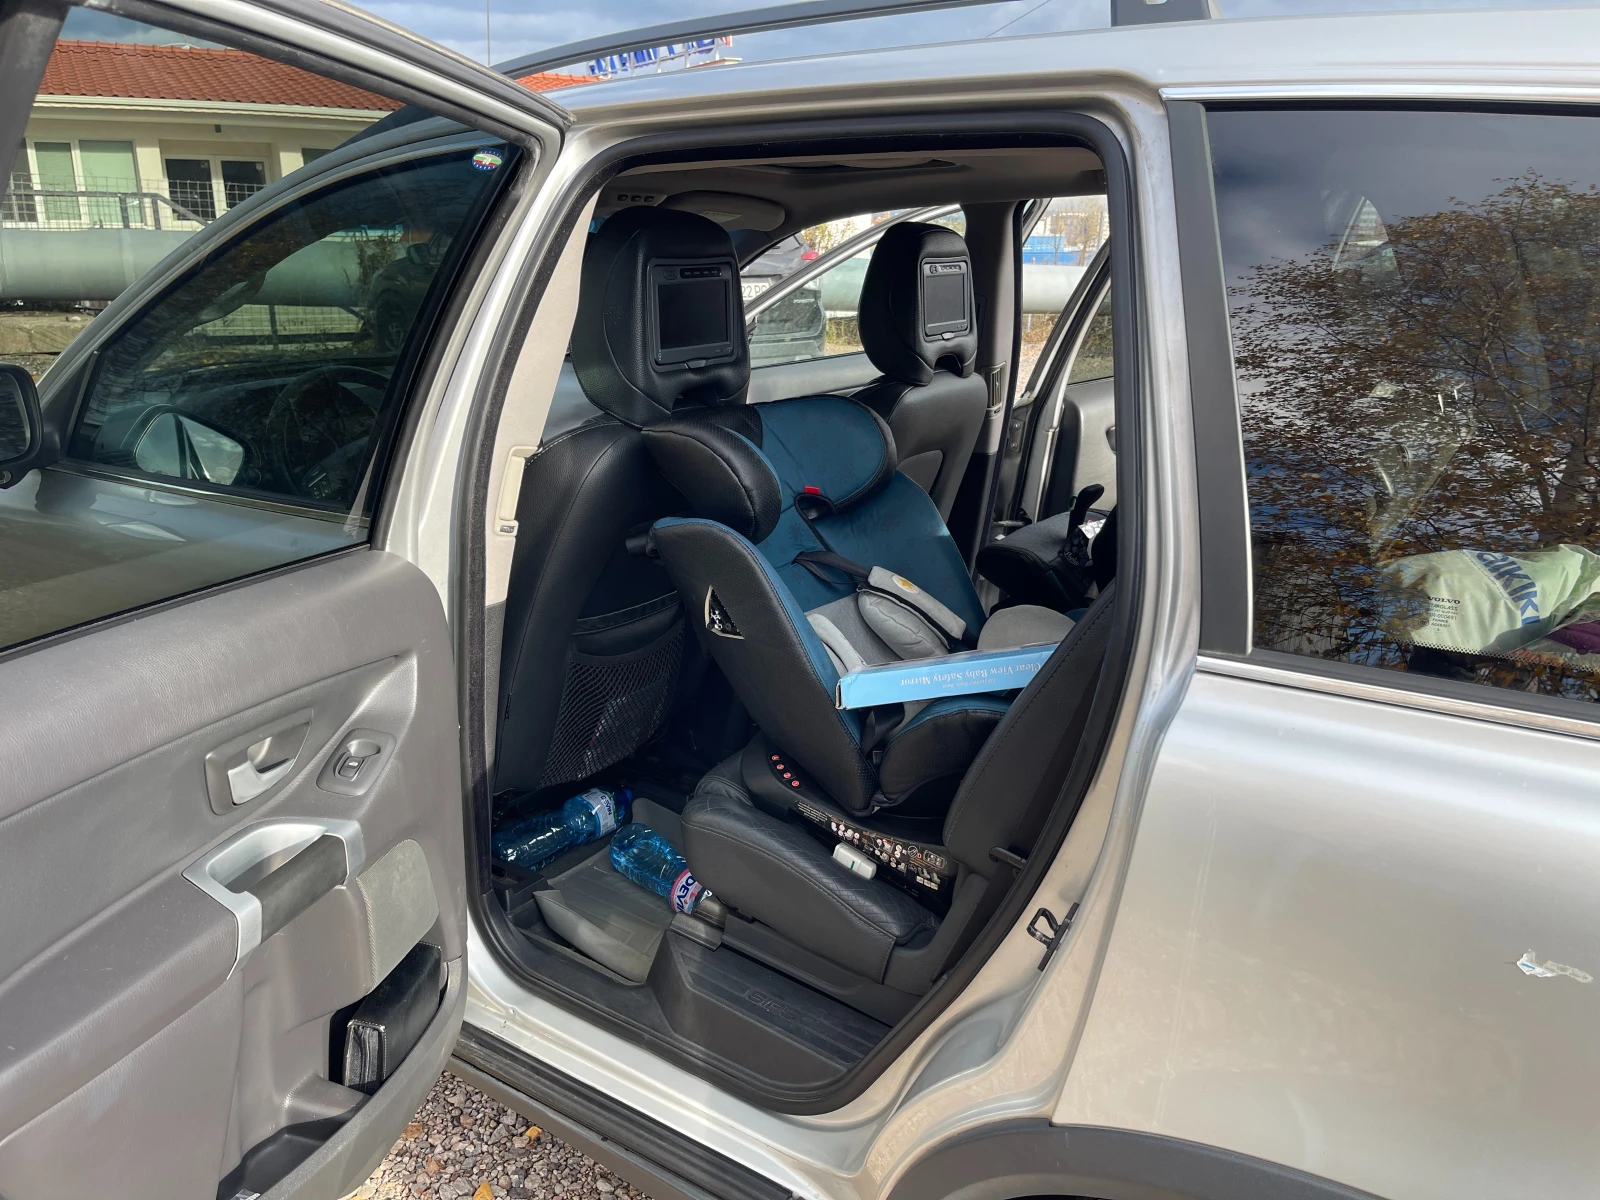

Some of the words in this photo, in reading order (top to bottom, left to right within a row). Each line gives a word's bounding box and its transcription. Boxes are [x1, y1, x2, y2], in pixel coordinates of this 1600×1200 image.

[1427, 596, 1460, 604] VOLVO
[988, 666, 1013, 676] View
[1014, 662, 1041, 672] Clear
[932, 670, 962, 684] Safety
[964, 667, 987, 679] Baby
[900, 675, 931, 686] Mirror
